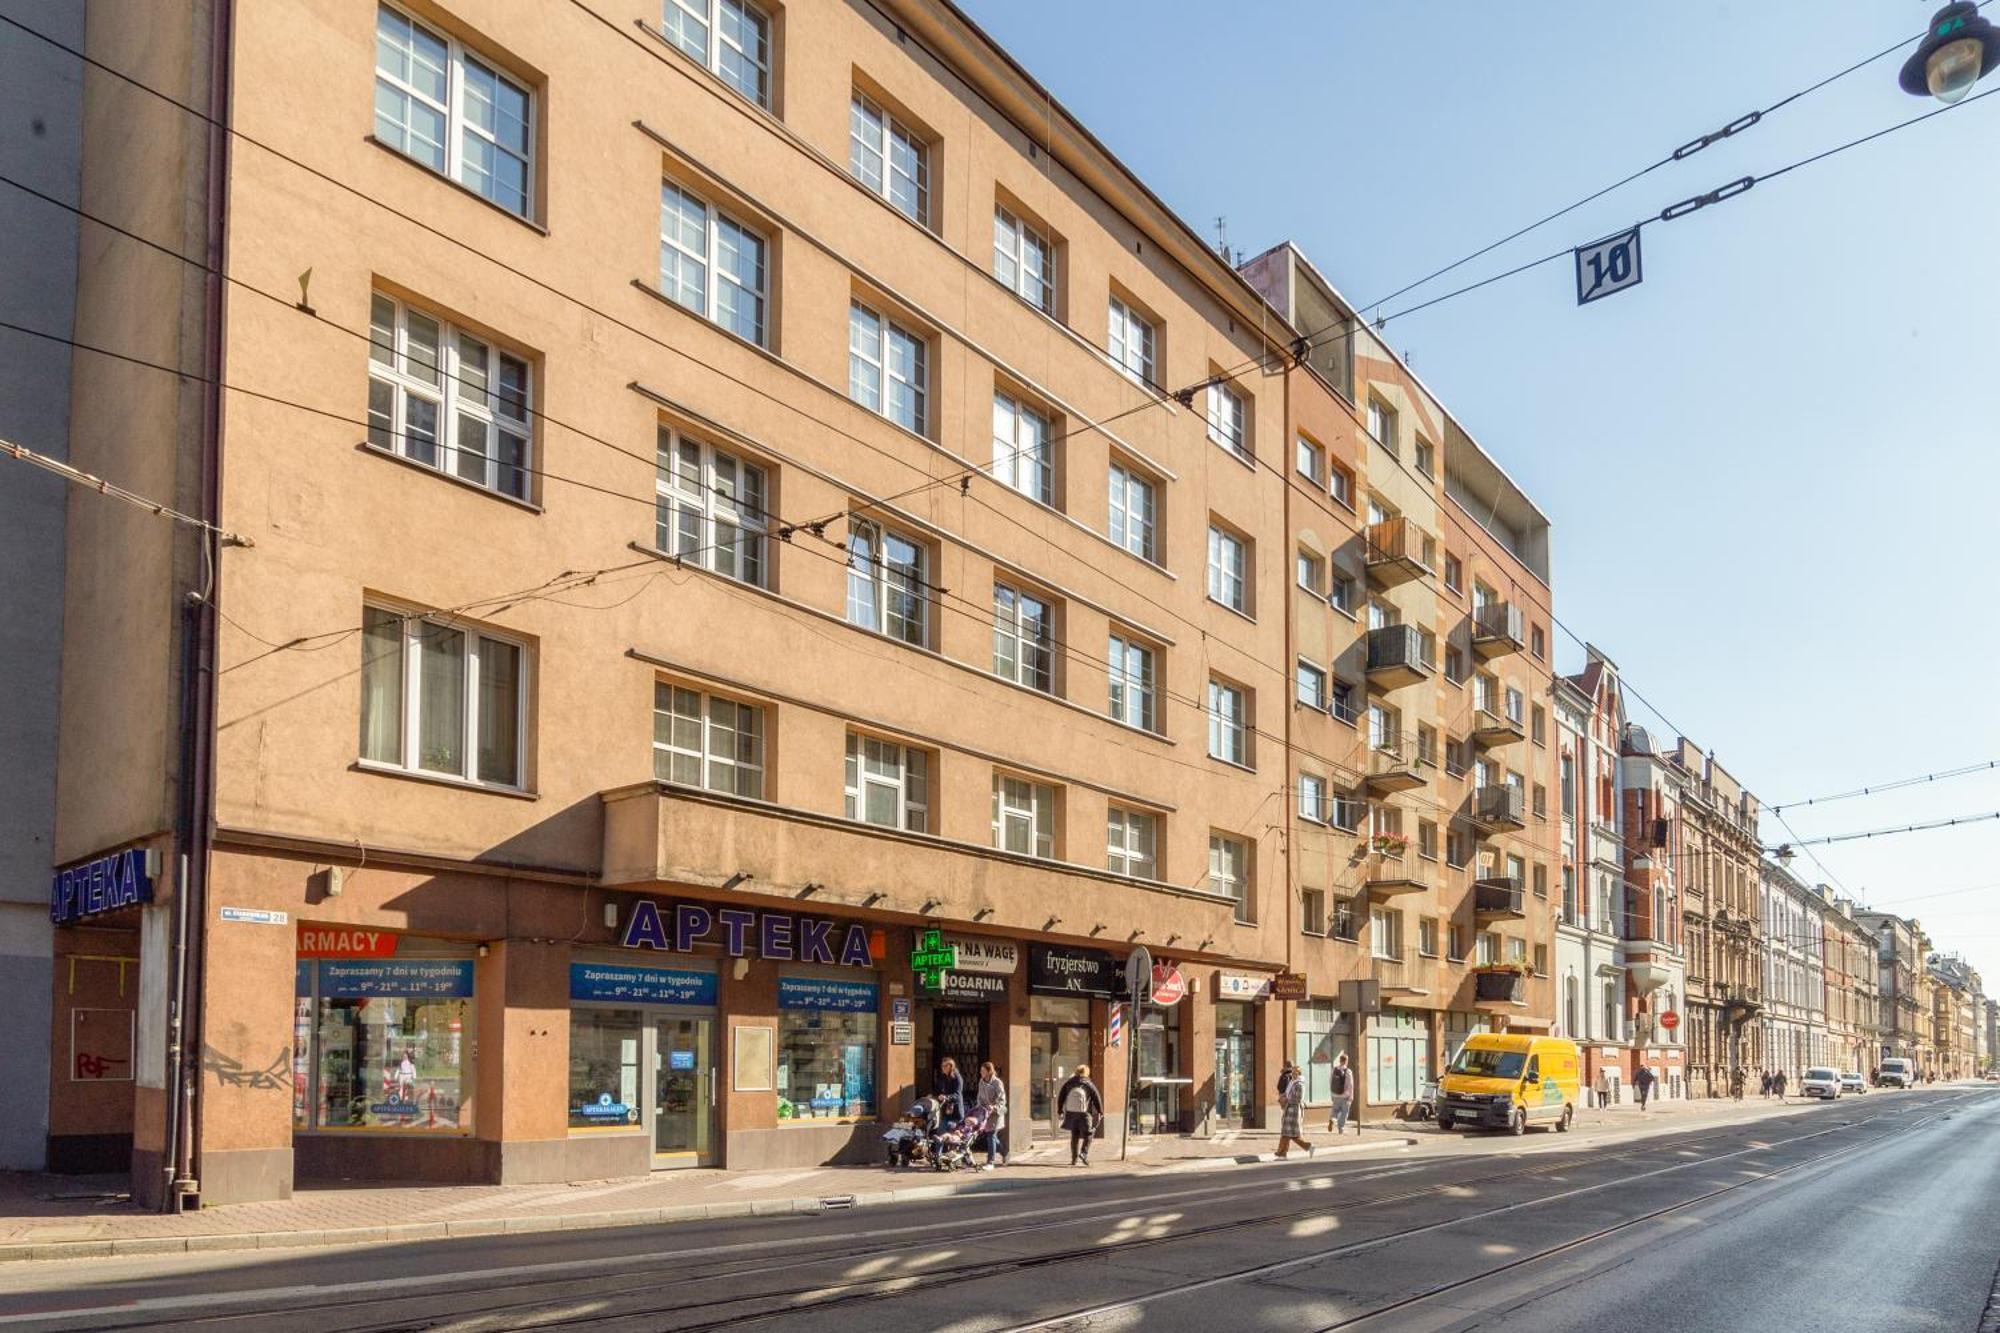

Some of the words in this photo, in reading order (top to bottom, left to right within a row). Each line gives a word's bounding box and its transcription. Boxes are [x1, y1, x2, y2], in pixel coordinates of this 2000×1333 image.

[1586, 243, 1632, 289] 10
[50, 849, 138, 921] APTEKA
[623, 900, 873, 968] APTEKA
[914, 951, 952, 966] APTEKA
[1047, 950, 1099, 975] fryzjerstwo
[329, 966, 383, 979] Zapraszamy
[386, 967, 391, 976] 7
[393, 966, 408, 976] dni
[410, 968, 418, 976] w
[419, 966, 462, 978] tygodniu
[584, 970, 637, 983] Zapraszamy
[644, 973, 658, 983] dni
[1065, 978, 1081, 991] AN
